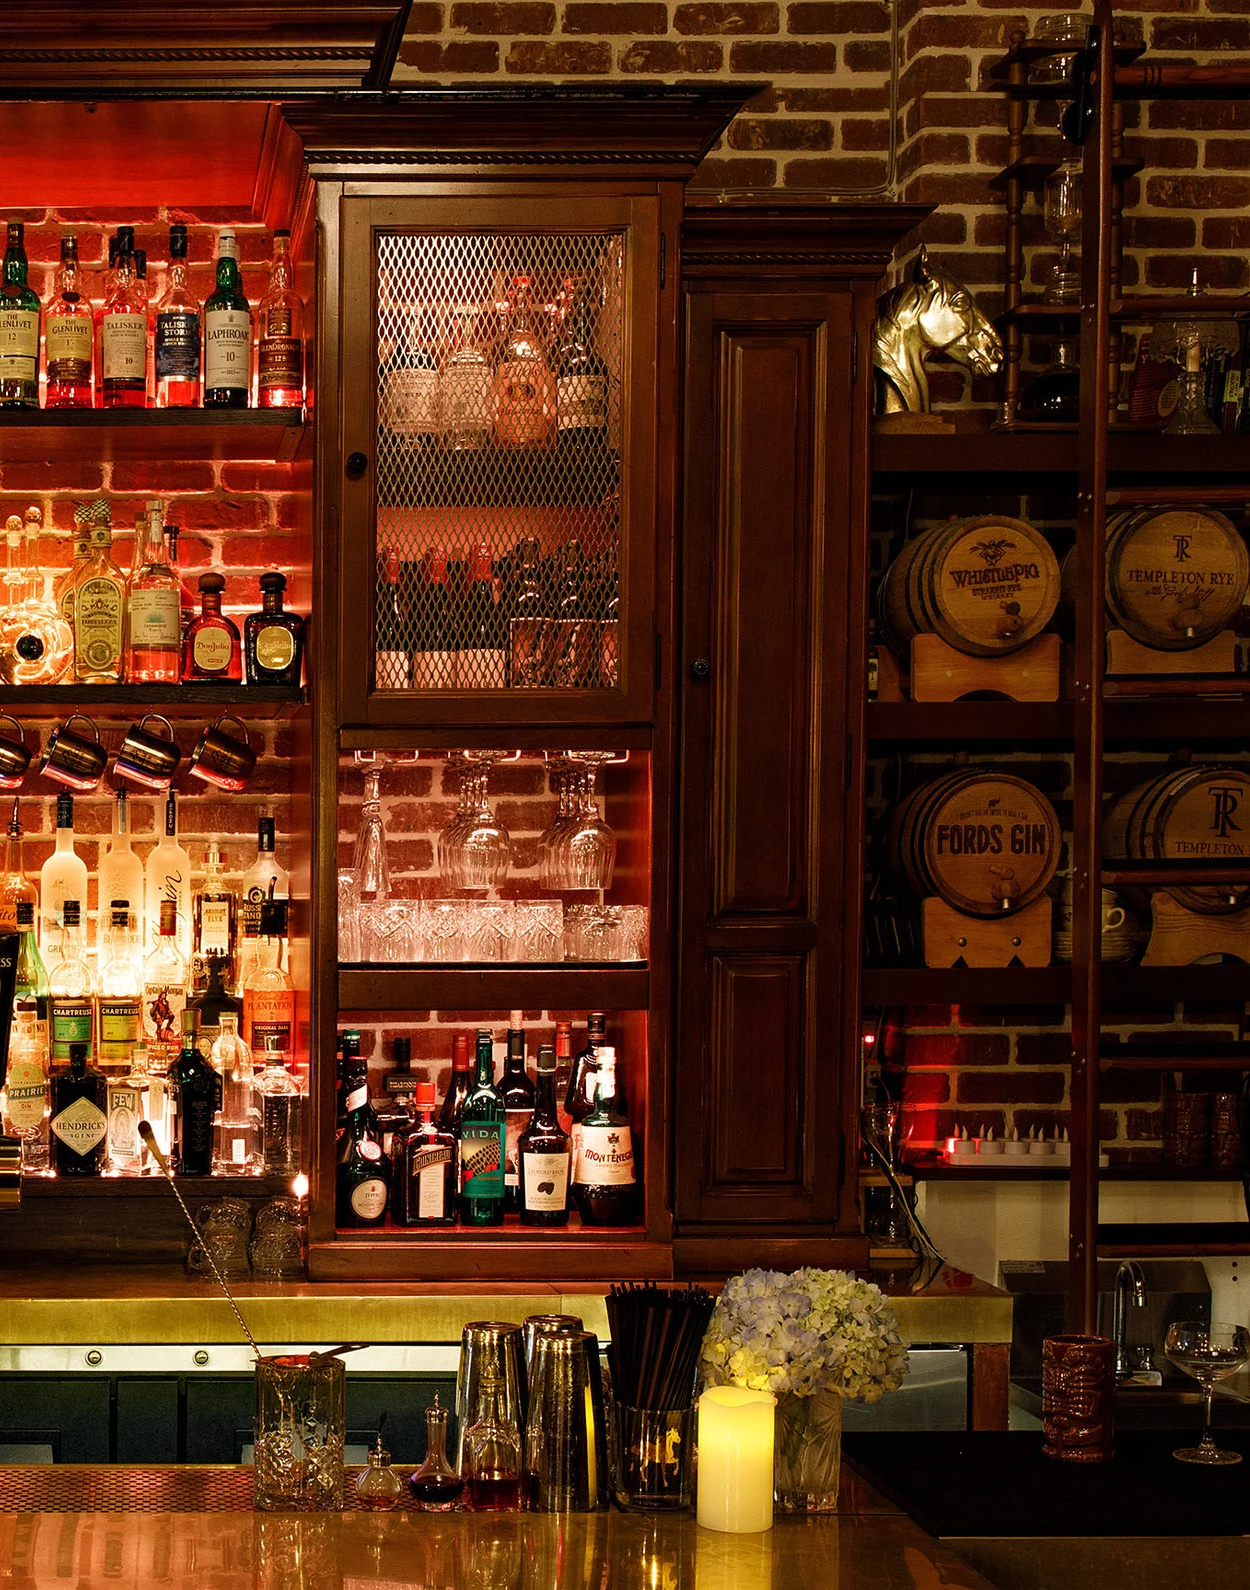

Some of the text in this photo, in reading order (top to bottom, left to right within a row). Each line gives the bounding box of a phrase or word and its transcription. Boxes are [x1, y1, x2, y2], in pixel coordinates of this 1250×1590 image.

[52, 326, 88, 335] GLENLIVET
[106, 322, 143, 330] TALISKER
[8, 333, 17, 341] 12
[125, 357, 134, 365] 10
[226, 351, 236, 362] 10
[948, 563, 1040, 589] WHISTLEPIG
[1126, 570, 1235, 586] TEMPLETON RYE
[937, 824, 1046, 855] FORDS GIN
[1174, 841, 1245, 856] TEMPLETON
[208, 915, 223, 923] ELYX
[164, 985, 184, 996] Morgan
[248, 1000, 293, 1011] PLANTATION
[9, 1086, 44, 1098] PRAIRIE
[112, 1093, 136, 1110] FEW
[56, 1122, 106, 1130] HENDRICK'S
[462, 1130, 498, 1140] VIDA
[414, 1149, 451, 1170] COINTREAU
[584, 1148, 633, 1164] MONTENEG
